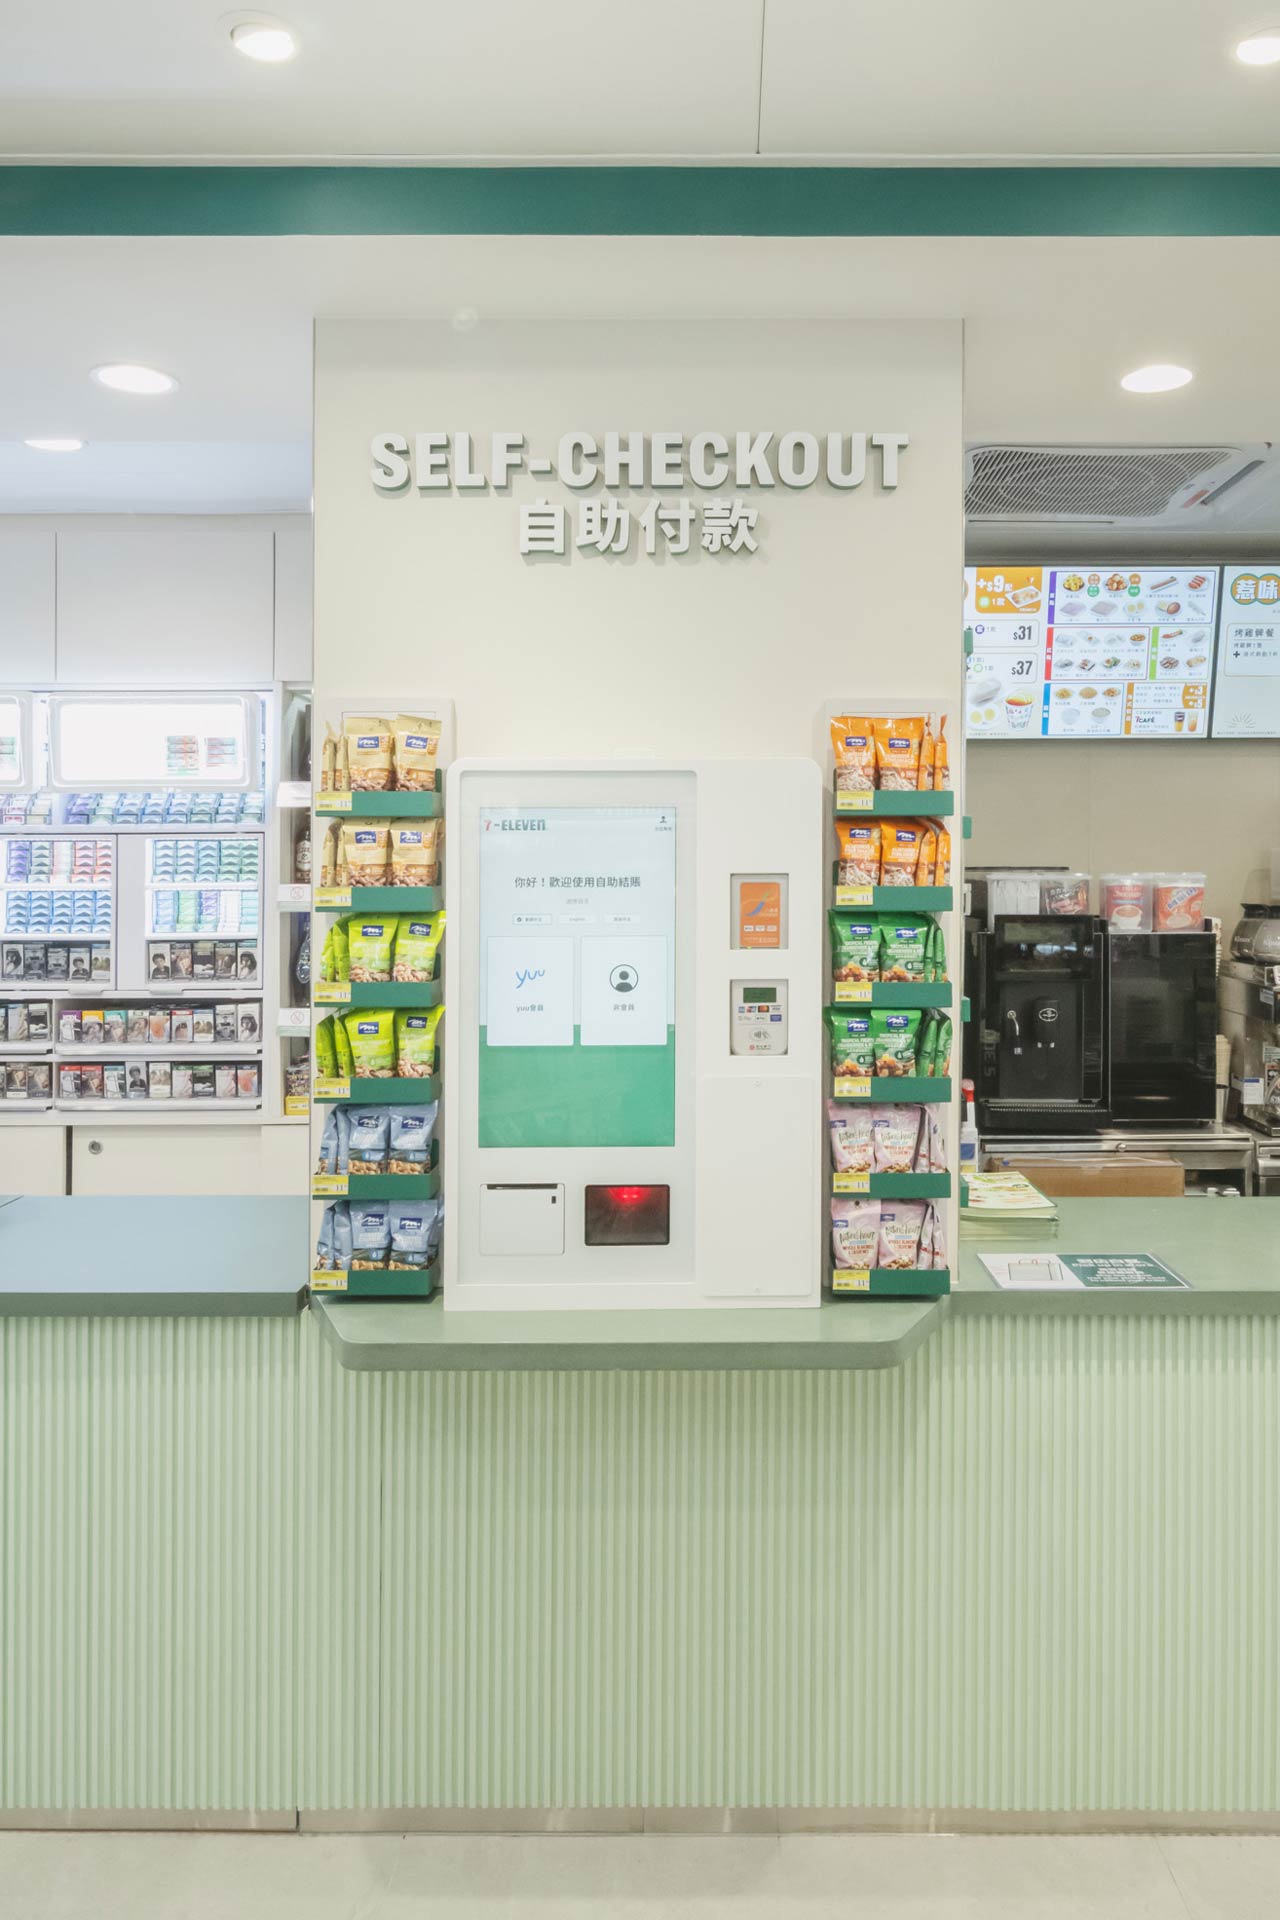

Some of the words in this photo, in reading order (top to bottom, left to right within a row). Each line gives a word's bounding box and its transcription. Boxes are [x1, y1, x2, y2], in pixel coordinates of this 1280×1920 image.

[369, 431, 910, 490] SELF-CHECKOUT
[519, 498, 759, 555] 自助付款
[1013, 625, 1033, 641] $31
[1011, 660, 1033, 676] $37
[515, 969, 546, 990] yuu
